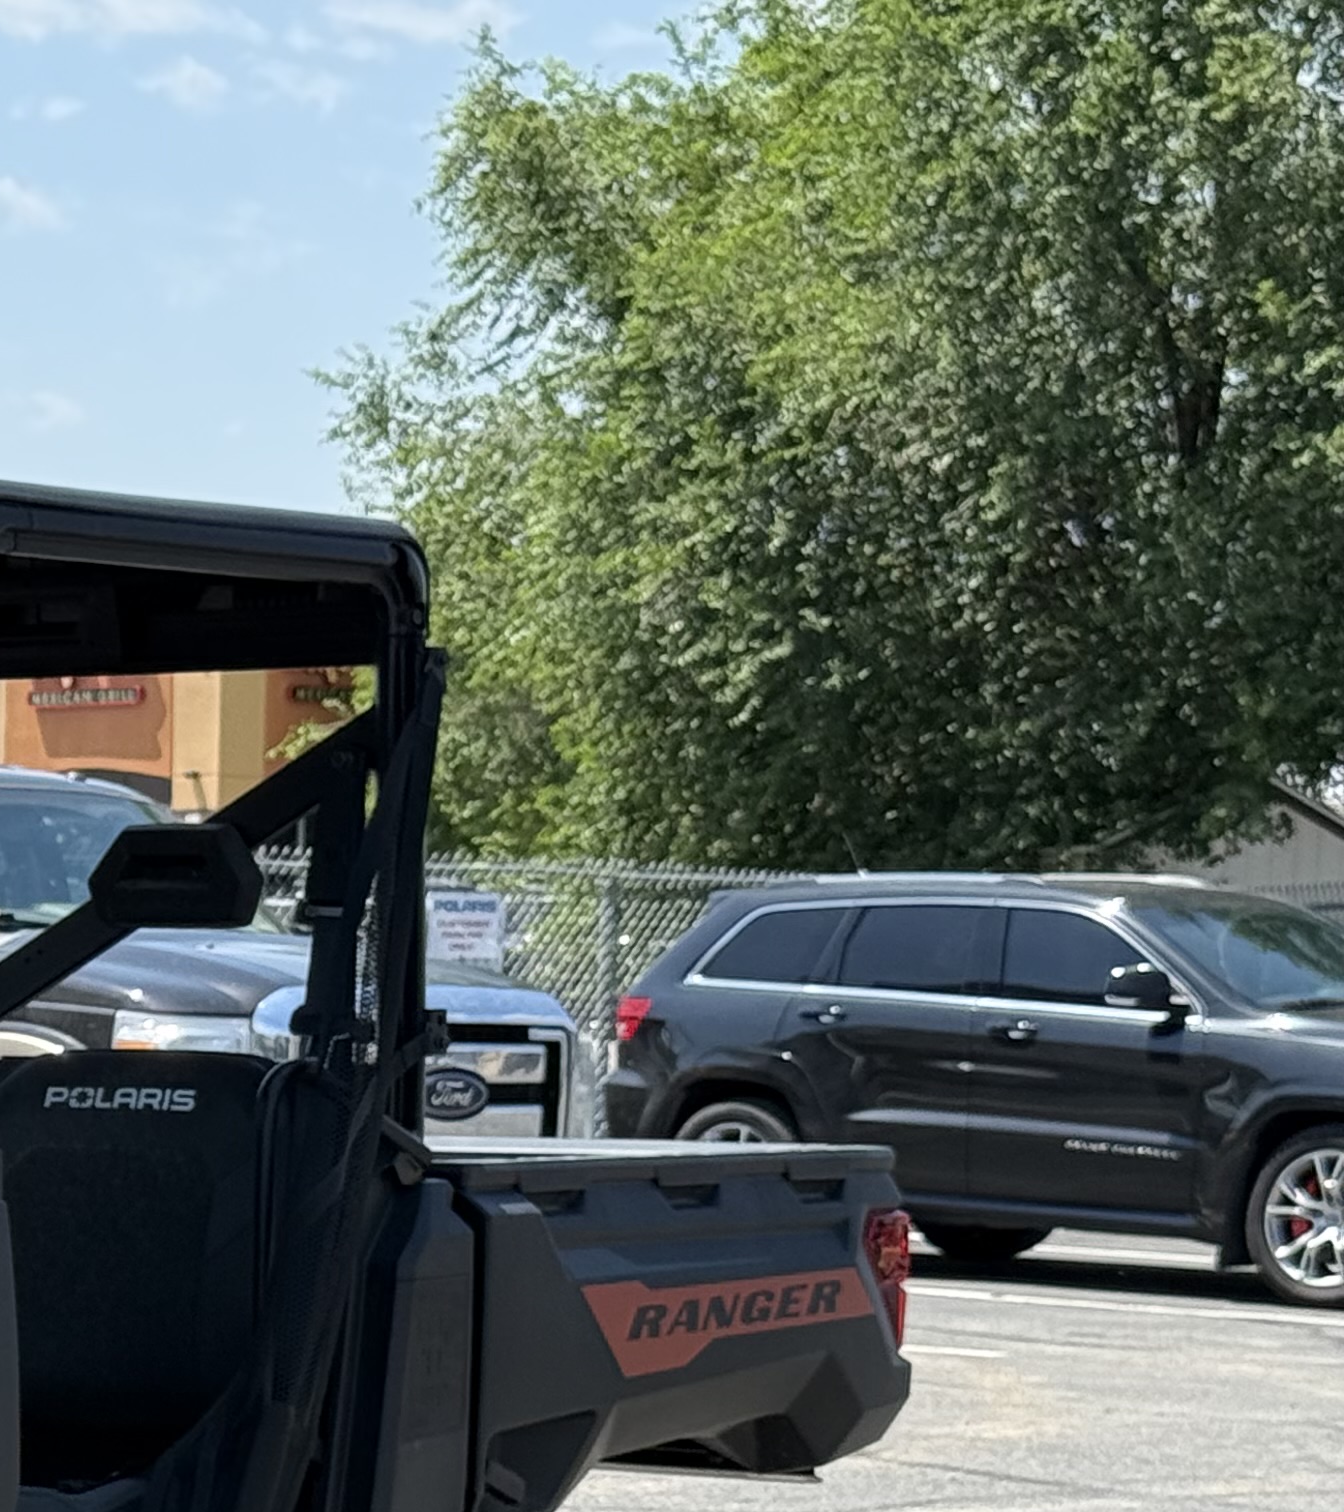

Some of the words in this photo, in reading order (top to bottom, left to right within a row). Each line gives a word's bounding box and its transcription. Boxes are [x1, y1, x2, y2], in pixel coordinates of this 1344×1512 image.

[43, 1086, 197, 1112] POLARIS
[431, 1081, 474, 1107] Ford
[627, 1279, 842, 1342] RANGER
